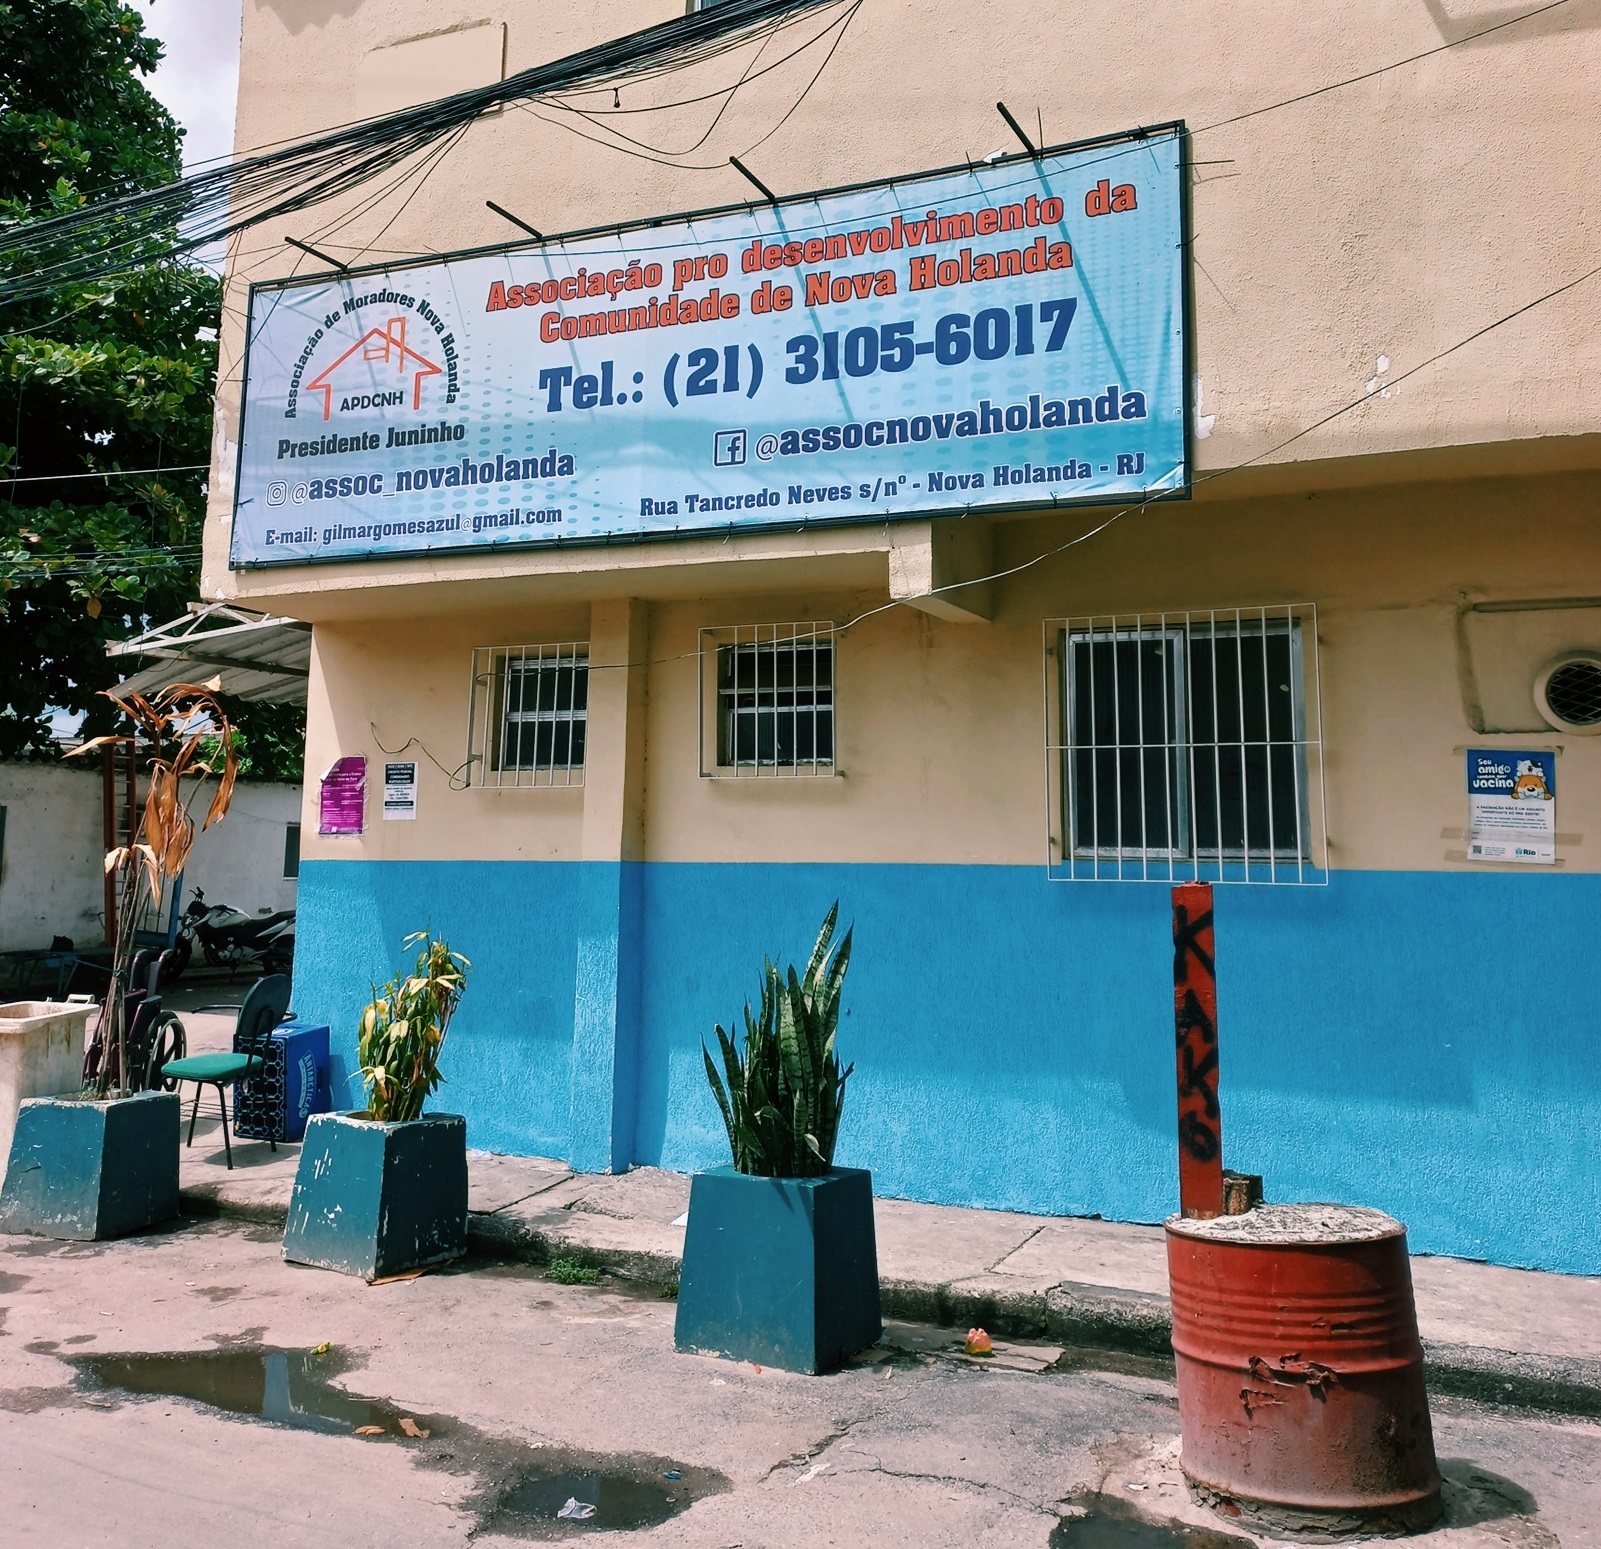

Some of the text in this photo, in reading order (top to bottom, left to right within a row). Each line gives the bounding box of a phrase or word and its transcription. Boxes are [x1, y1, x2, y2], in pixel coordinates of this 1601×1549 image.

[486, 178, 1137, 312] Associação pro desenvolvimento da
[539, 236, 1073, 343] Comunidade de Nova Holanda
[285, 288, 460, 418] Associação de Moradores Nova Holanda
[539, 297, 1078, 412] Tel.: (21) 3105-6017
[339, 391, 404, 412] APDCNH
[755, 384, 1147, 461] @assocnovaholanda
[277, 421, 465, 460] Presidente Juninho
[291, 449, 575, 505] @assoc_novaholanda
[640, 498, 679, 516] Rua
[684, 486, 781, 514] Tancredo
[787, 480, 852, 505] Neves
[927, 469, 985, 492] Nova
[993, 459, 1092, 486] Holanda
[1116, 453, 1145, 475] RJ
[265, 507, 562, 546] E-mail: gilmargomesazul@gmail.com
[1472, 778, 1514, 788] vacina
[1478, 763, 1511, 774] amigo
[303, 1053, 314, 1108] ANTARCTICA
